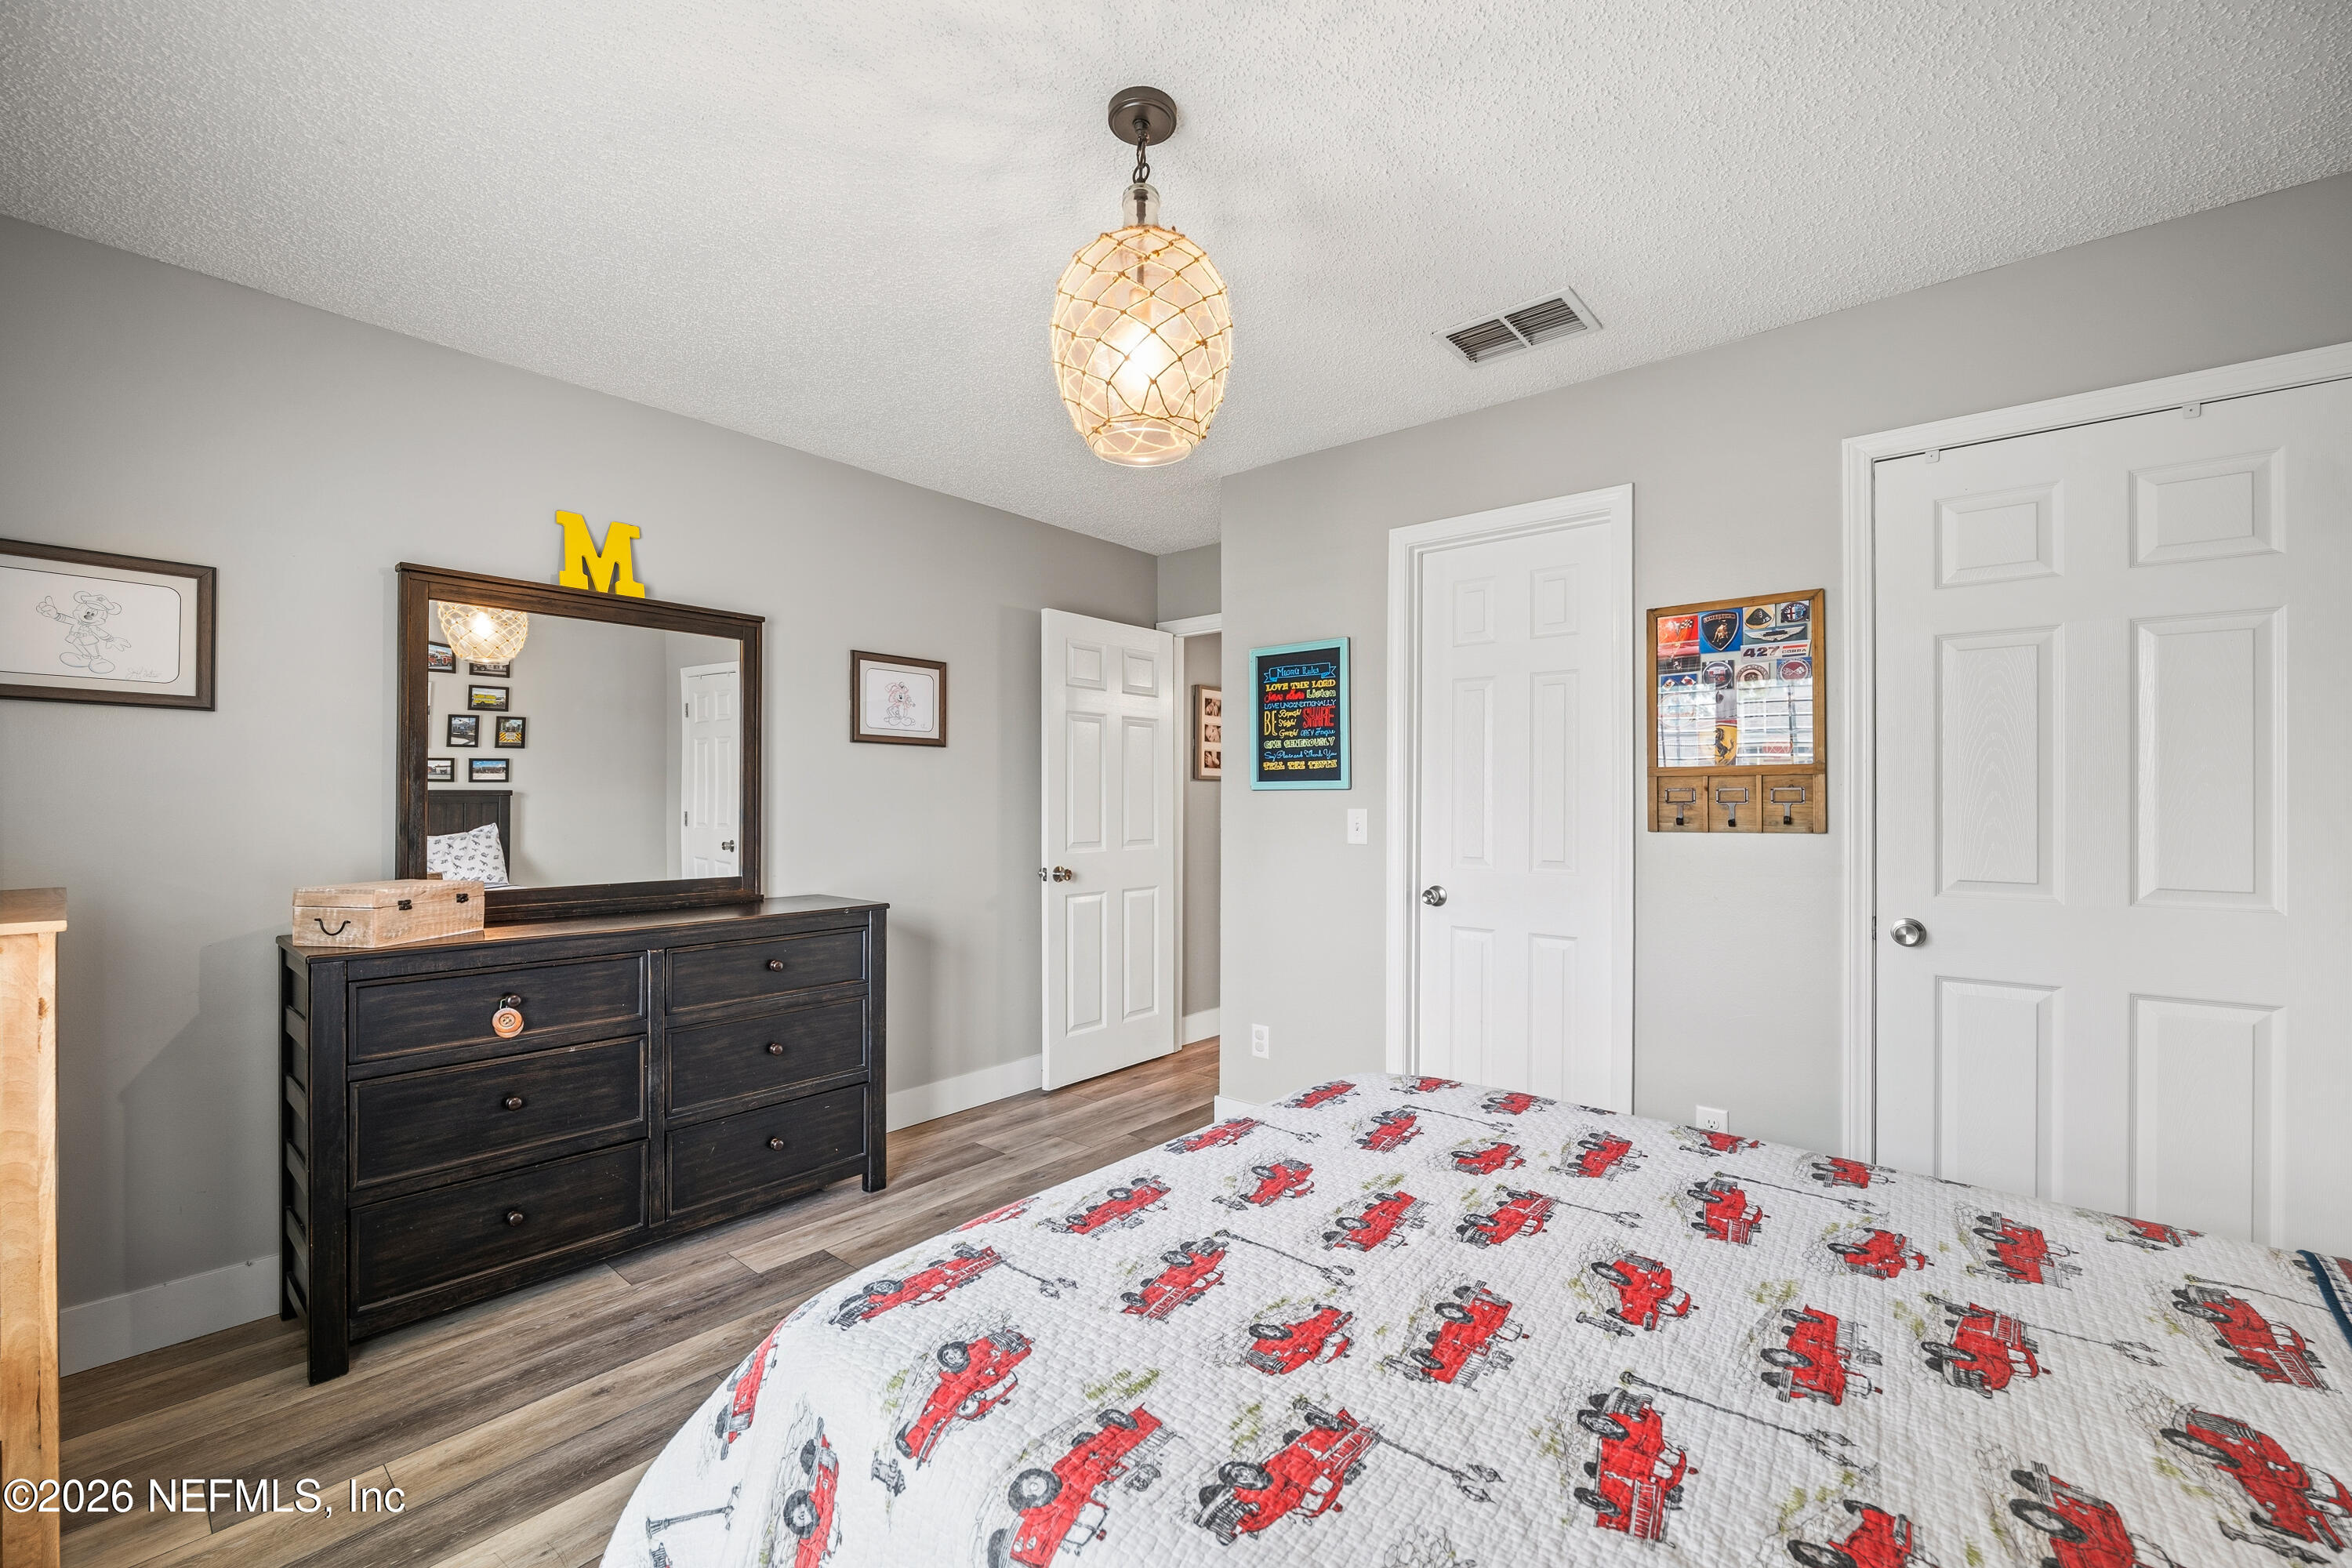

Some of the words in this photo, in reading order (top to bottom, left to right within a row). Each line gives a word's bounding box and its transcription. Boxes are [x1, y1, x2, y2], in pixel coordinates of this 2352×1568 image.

[556, 510, 645, 598] M
[1743, 646, 1780, 657] 427
[1302, 666, 1319, 675] Rules
[1265, 683, 1288, 691] LOVE
[1312, 679, 1336, 688] LORD
[1306, 689, 1336, 699] Listen
[1280, 699, 1337, 709] UNCONDITIONALLY
[1264, 710, 1278, 736] BE
[1302, 706, 1336, 728] SHARE
[1264, 739, 1282, 749] GIVE
[1283, 737, 1336, 748] GENEROUSLY
